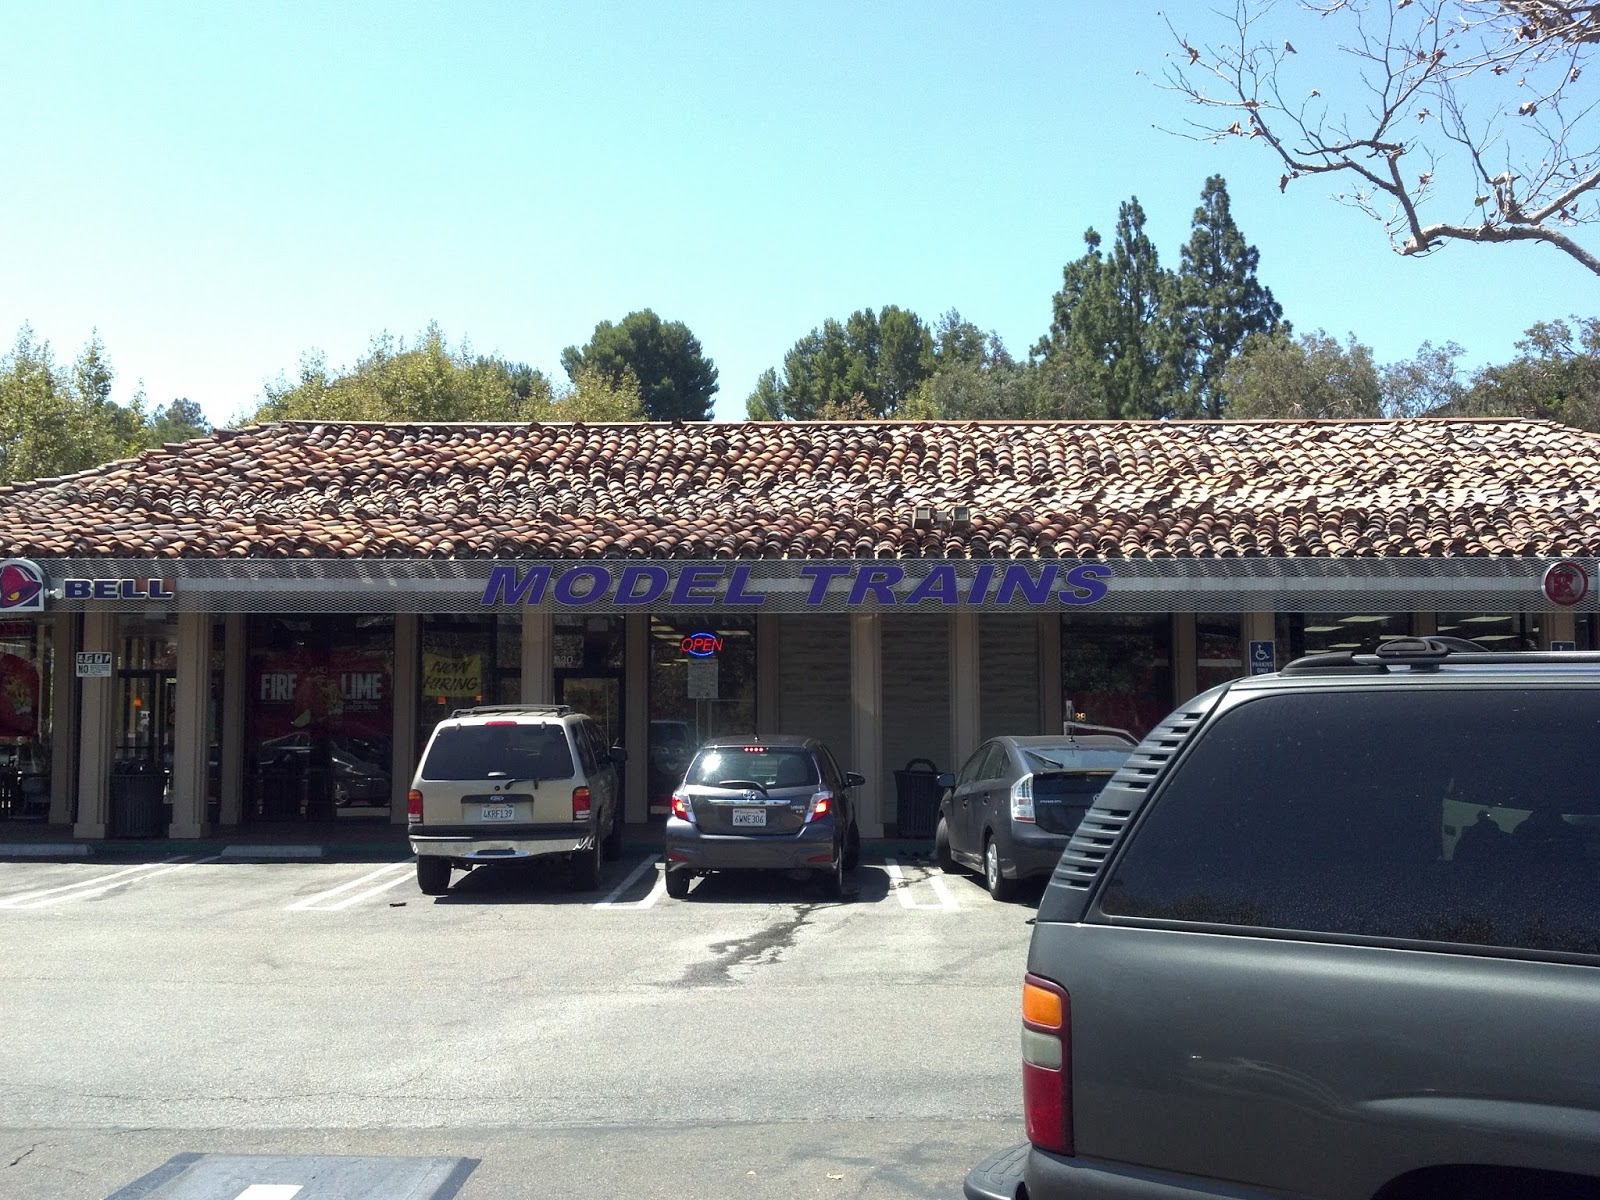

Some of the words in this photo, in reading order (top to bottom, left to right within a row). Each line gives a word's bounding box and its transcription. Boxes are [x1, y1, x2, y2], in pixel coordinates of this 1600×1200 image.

[64, 578, 175, 599] BELL
[480, 565, 767, 606] MODEL
[800, 565, 1113, 606] TRAINS
[681, 637, 724, 652] OPEN
[431, 660, 474, 674] NOW
[341, 673, 382, 700] LIME
[423, 676, 478, 691] HIRING
[483, 809, 513, 819] 4KRF139
[734, 814, 764, 824] 6WNE306
